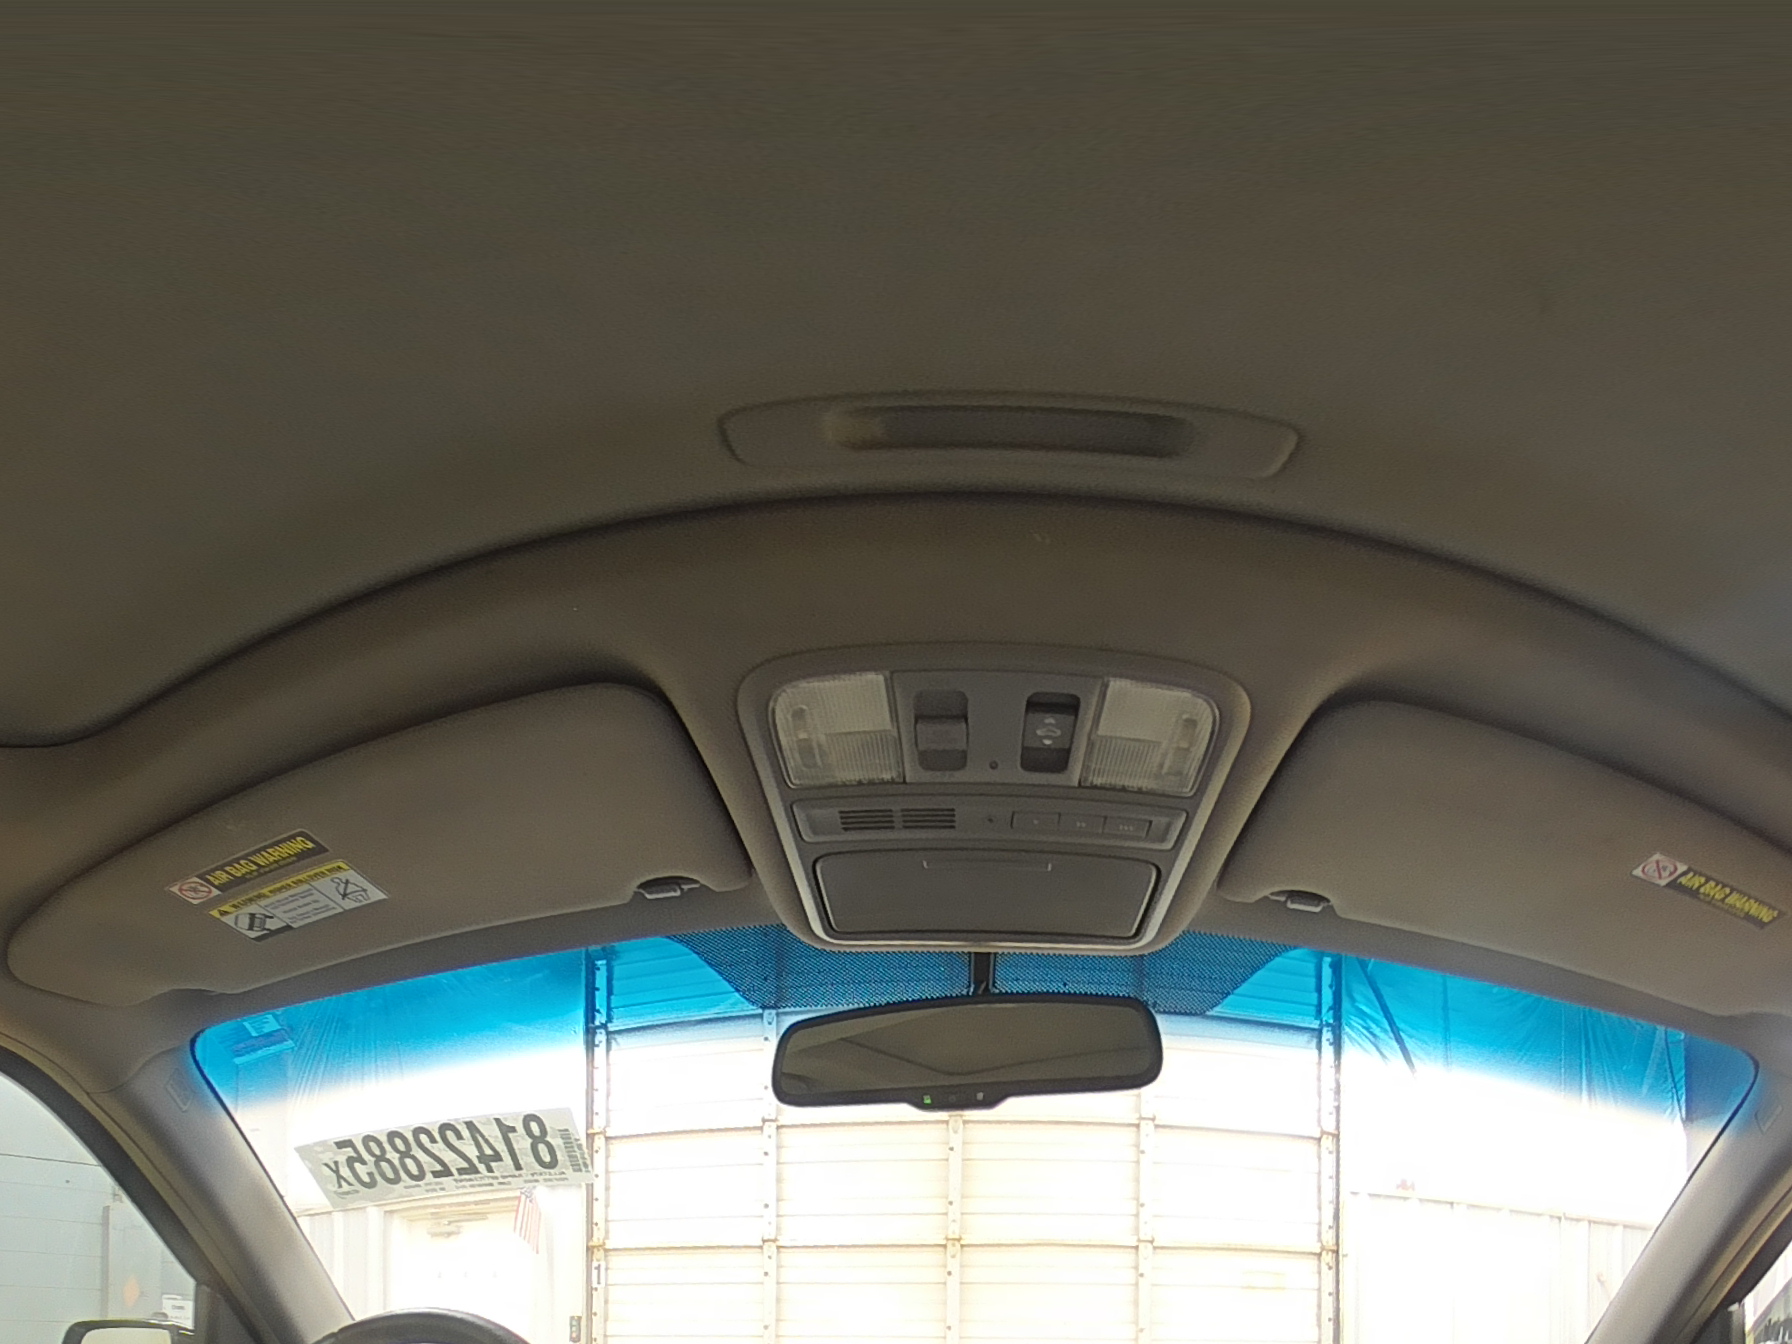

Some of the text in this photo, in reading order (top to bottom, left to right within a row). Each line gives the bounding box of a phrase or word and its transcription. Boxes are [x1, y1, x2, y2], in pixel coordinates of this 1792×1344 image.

[206, 870, 234, 886] AIR
[225, 860, 259, 877] BAG
[250, 837, 316, 867] WARNING
